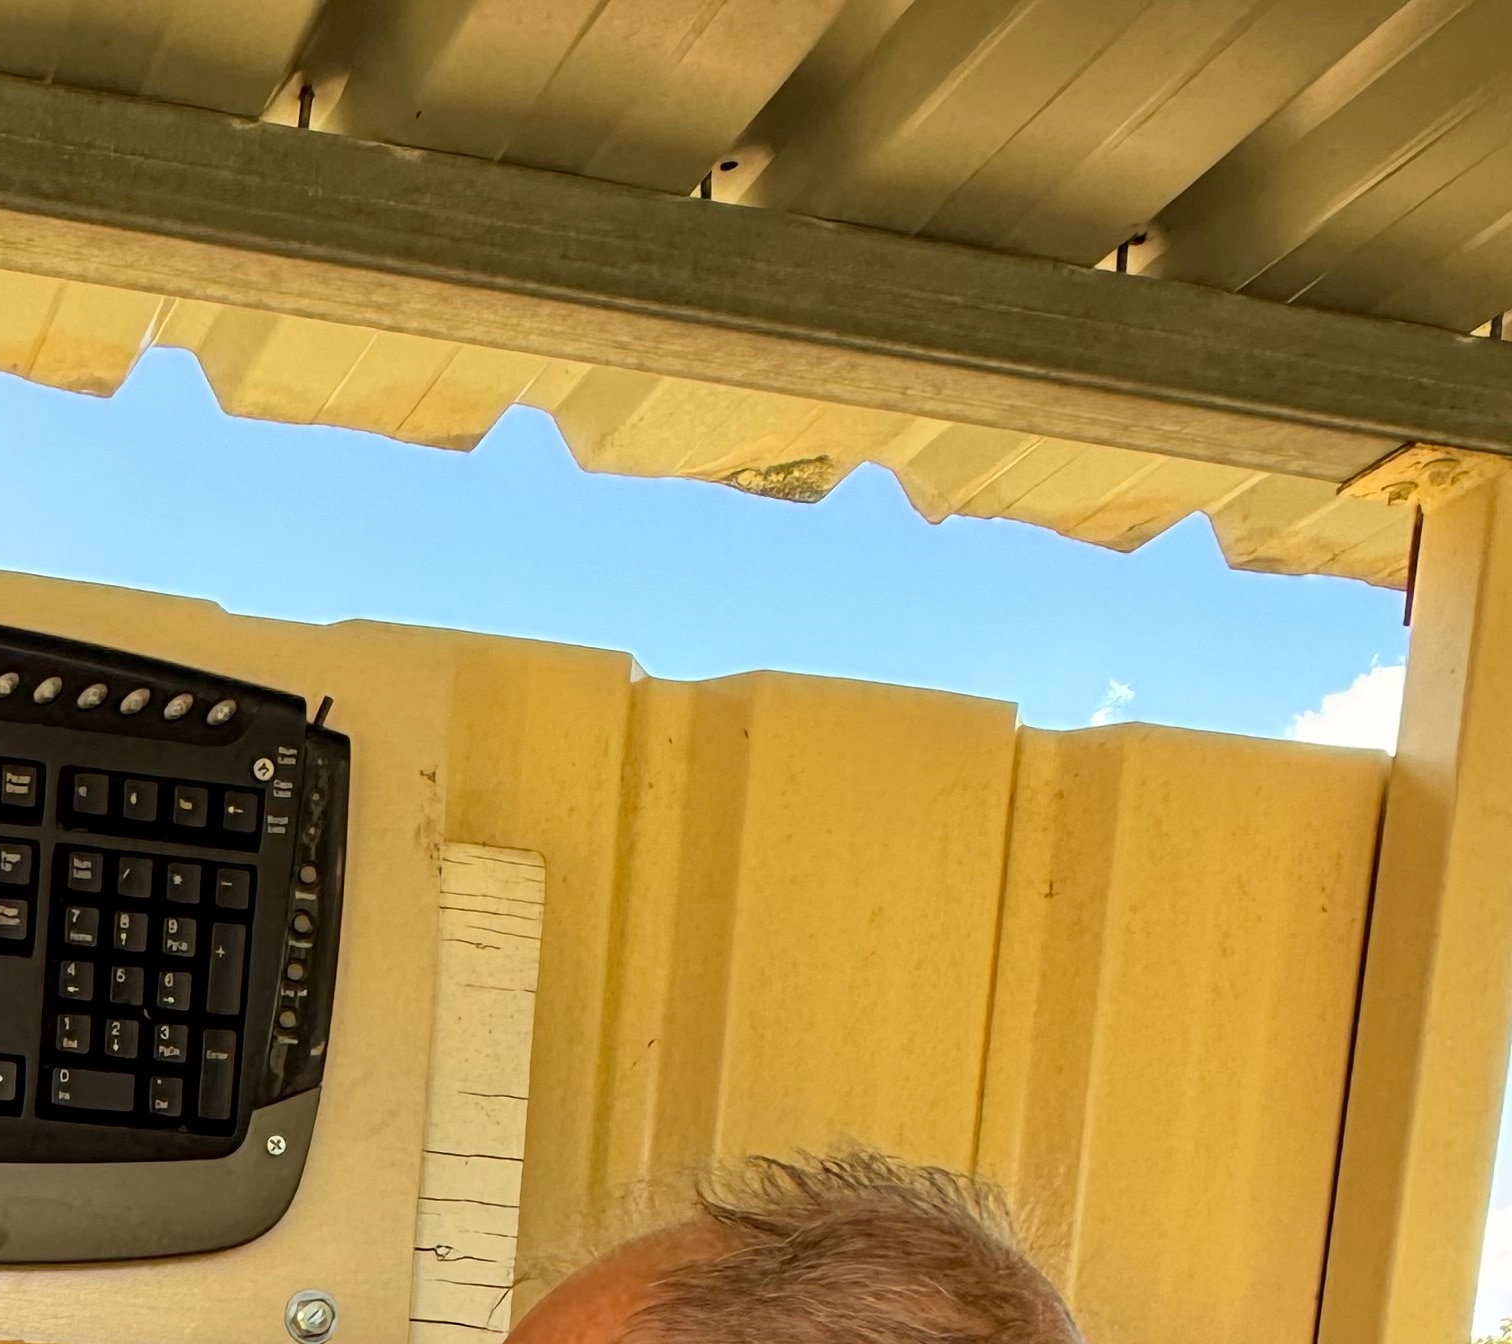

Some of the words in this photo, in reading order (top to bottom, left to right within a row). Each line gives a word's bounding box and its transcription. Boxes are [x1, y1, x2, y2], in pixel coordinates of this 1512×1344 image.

[71, 908, 81, 923] 7
[119, 913, 130, 929] 8
[168, 919, 178, 934] 9
[66, 962, 76, 976] 4
[64, 1017, 70, 1031] 1
[111, 1021, 121, 1036] 2
[160, 1025, 170, 1040] 3
[59, 1069, 70, 1083] 0
